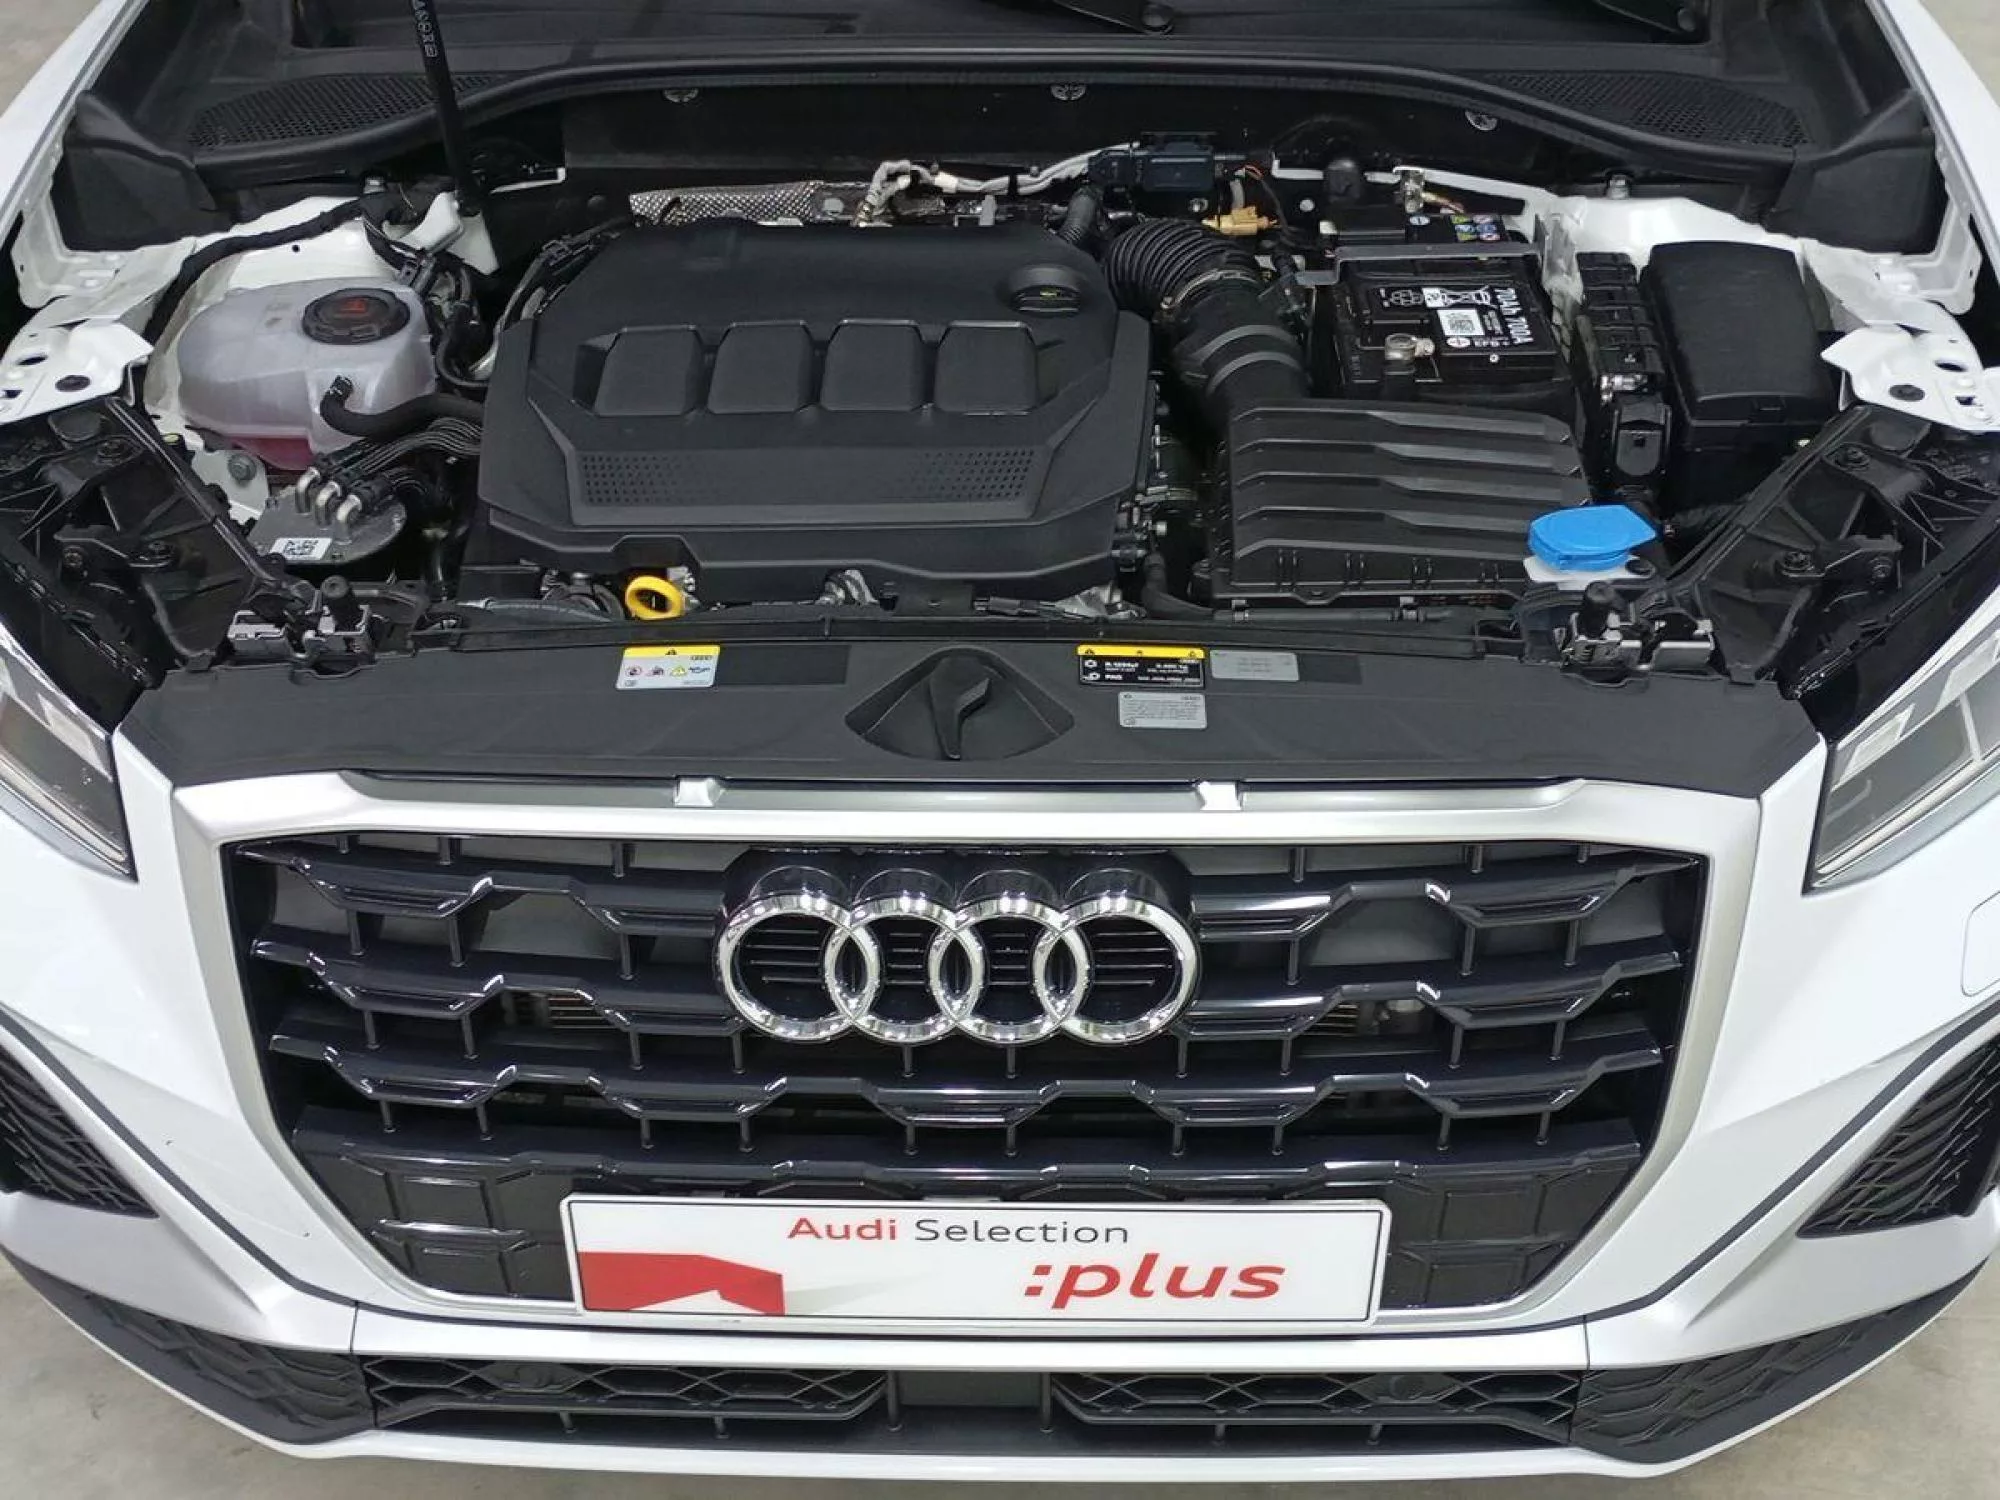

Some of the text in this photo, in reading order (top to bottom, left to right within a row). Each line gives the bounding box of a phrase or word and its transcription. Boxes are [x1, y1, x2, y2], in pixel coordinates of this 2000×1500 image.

[787, 1217, 1129, 1244] Audi Selection
[1024, 1252, 1287, 1310] :plus
